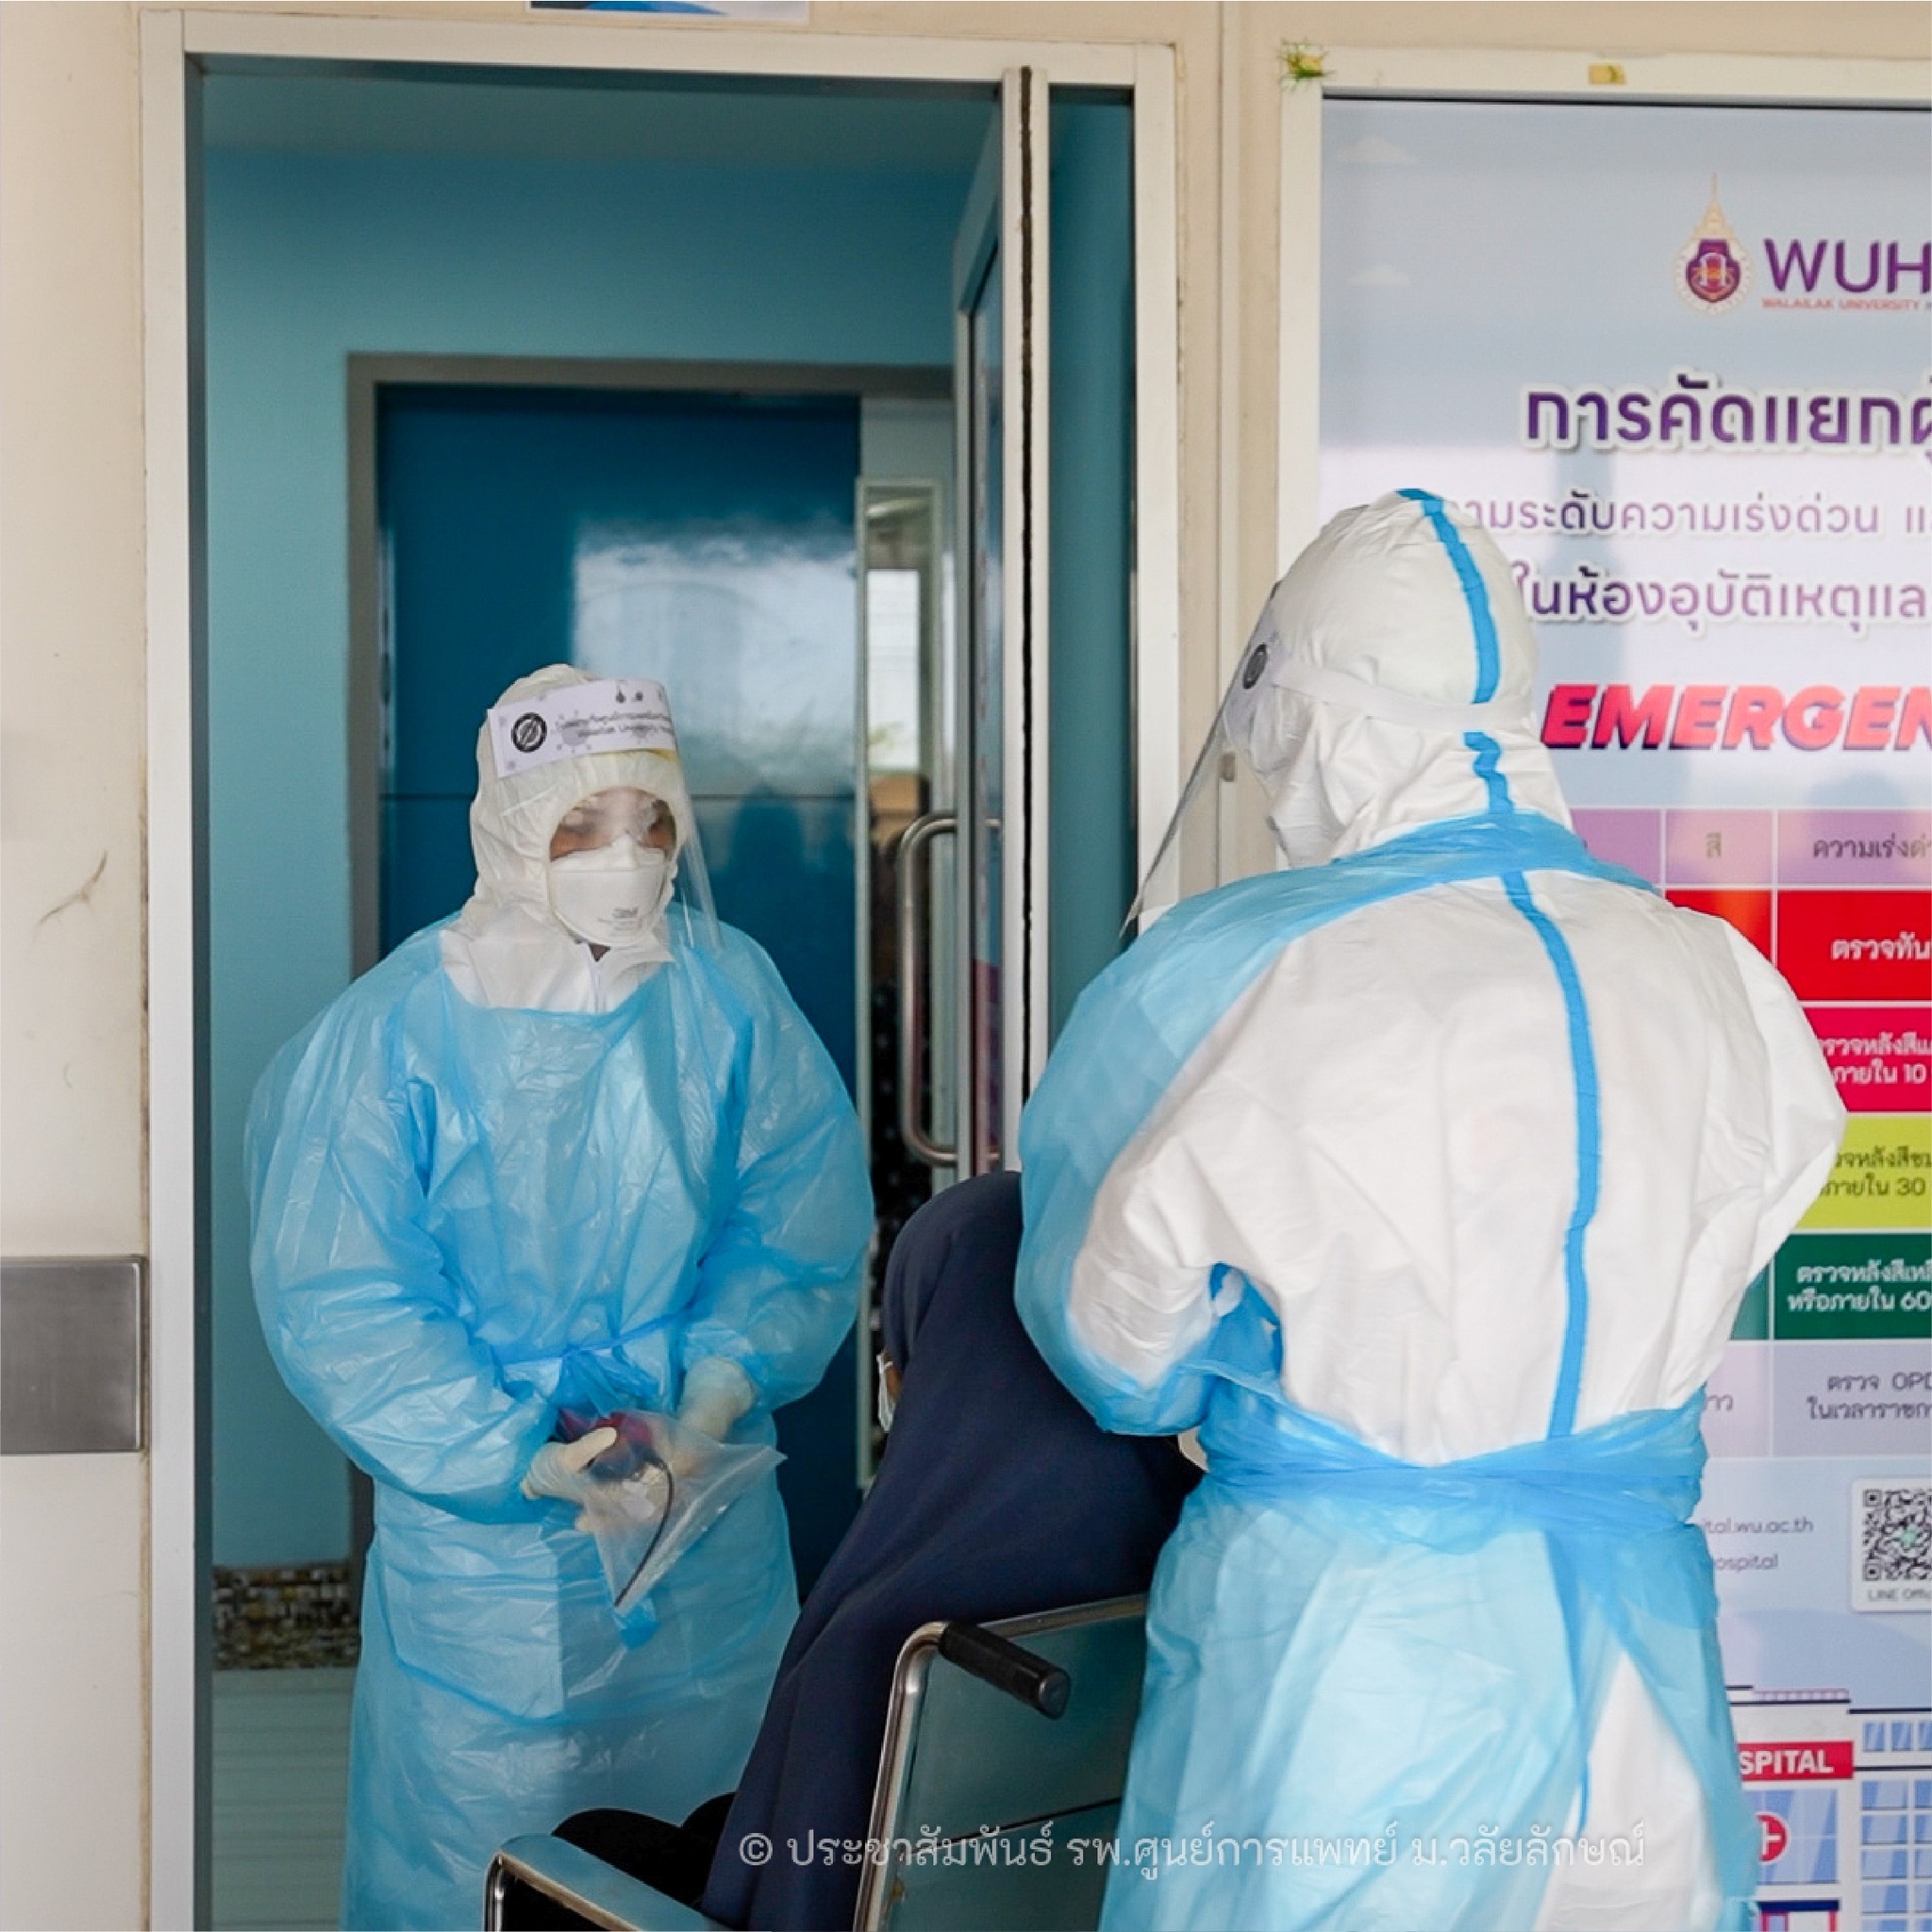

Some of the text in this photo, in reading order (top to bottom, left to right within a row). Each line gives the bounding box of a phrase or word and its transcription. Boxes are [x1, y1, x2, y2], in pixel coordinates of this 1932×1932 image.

[1763, 239, 1932, 293] WUH
[1465, 490, 1878, 533] ามระดับความเร่งด่วน
[1903, 1063, 1927, 1085] 10
[1895, 1175, 1926, 1197] 30
[1714, 1553, 1779, 1574] ospital
[1739, 1749, 1835, 1774] SPITAL
